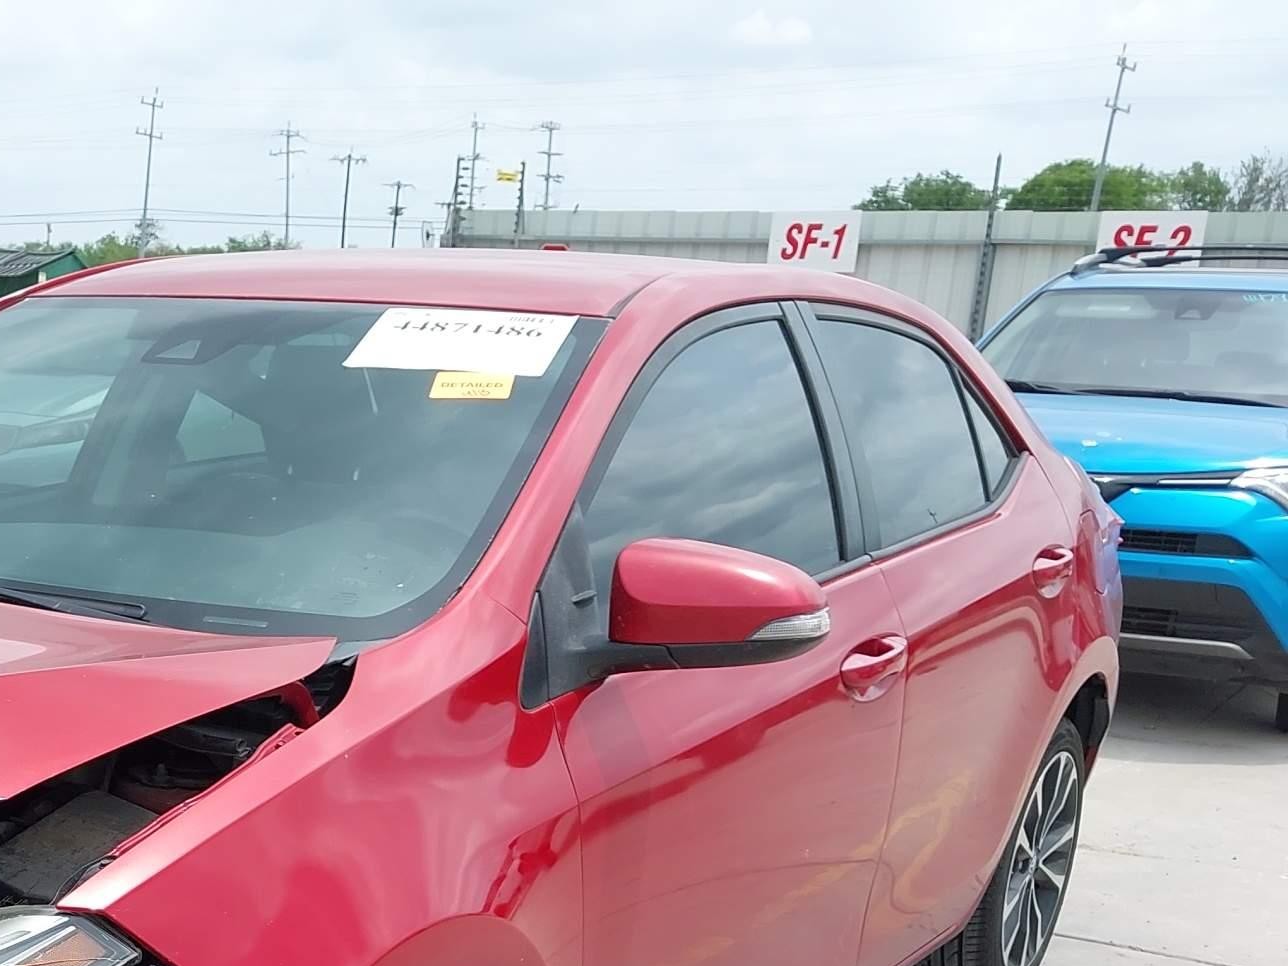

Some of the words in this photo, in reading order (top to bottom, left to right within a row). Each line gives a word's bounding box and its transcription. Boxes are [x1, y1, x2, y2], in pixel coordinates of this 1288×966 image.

[780, 223, 848, 261] SF-1
[1113, 224, 1193, 258] SF2
[393, 320, 544, 338] 44871486
[440, 381, 504, 389] DETAILED
